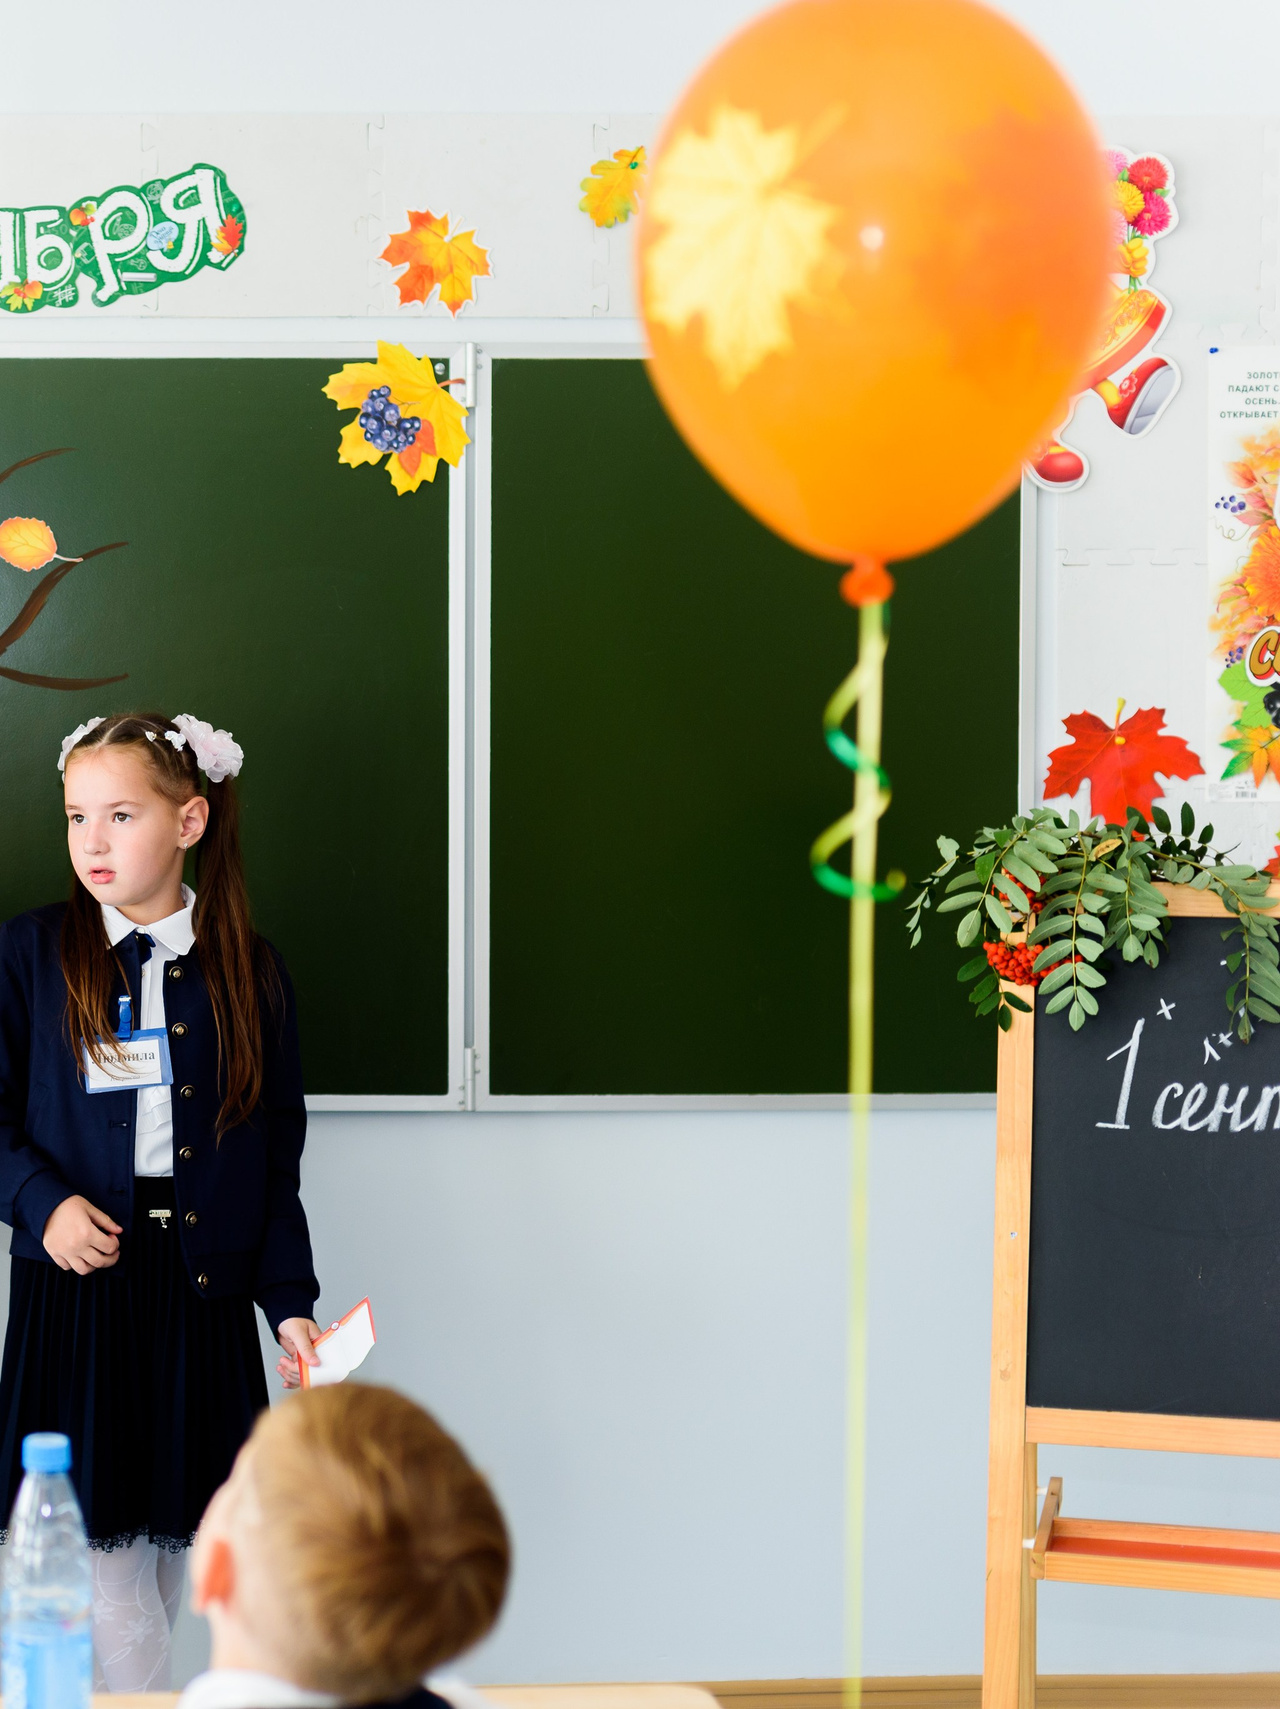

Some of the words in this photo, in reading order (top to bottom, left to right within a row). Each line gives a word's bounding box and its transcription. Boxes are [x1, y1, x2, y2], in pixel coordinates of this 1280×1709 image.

[1247, 371, 1280, 379] ЗОЛОТ
[1228, 384, 1270, 393] ПАДАЮТ
[1220, 410, 1278, 418] ОТКРЫВАЕТ
[1095, 1017, 1145, 1130] 1
